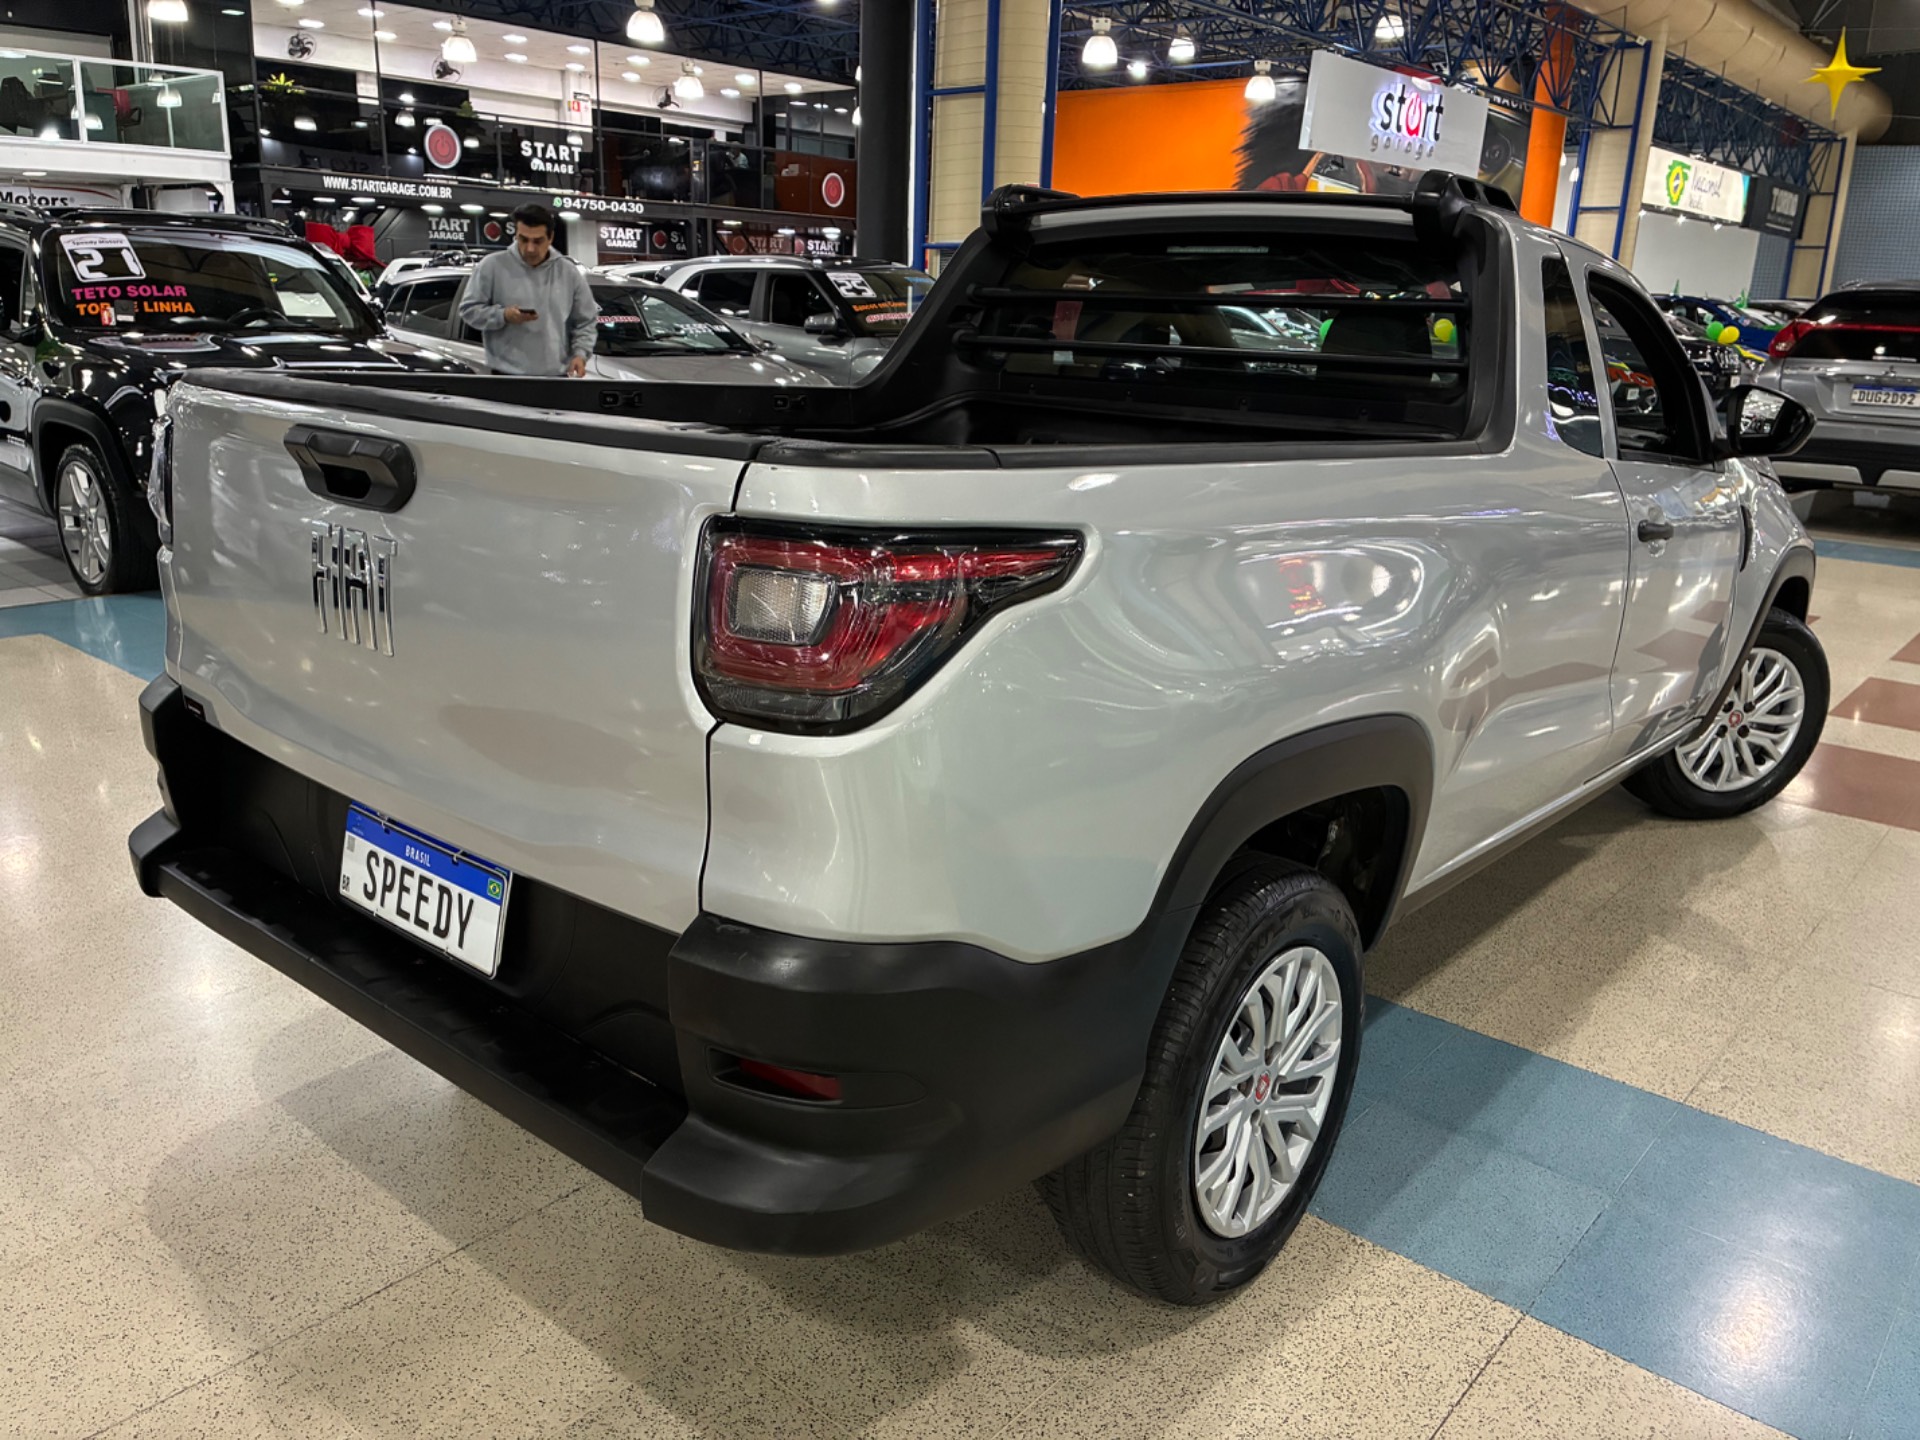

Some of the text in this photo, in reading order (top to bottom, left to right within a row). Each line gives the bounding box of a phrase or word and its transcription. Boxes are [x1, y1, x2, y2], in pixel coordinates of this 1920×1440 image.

[520, 140, 582, 162] START
[530, 159, 575, 174] GARAGE
[322, 176, 453, 199] WWW.STARTGARAGE.COM.BR
[562, 197, 645, 214] 94750-0430
[600, 226, 643, 241] START
[606, 239, 638, 248] GARAGE
[807, 239, 841, 252] START
[71, 285, 187, 300] TETO SOLAR
[837, 280, 872, 296] 25
[143, 301, 195, 313] LINHA
[1857, 390, 1916, 405] DUG2D92
[312, 520, 398, 657] FIAT
[405, 844, 431, 867] BRASIL
[342, 873, 351, 892] BR
[362, 849, 474, 950] SPEEDY
